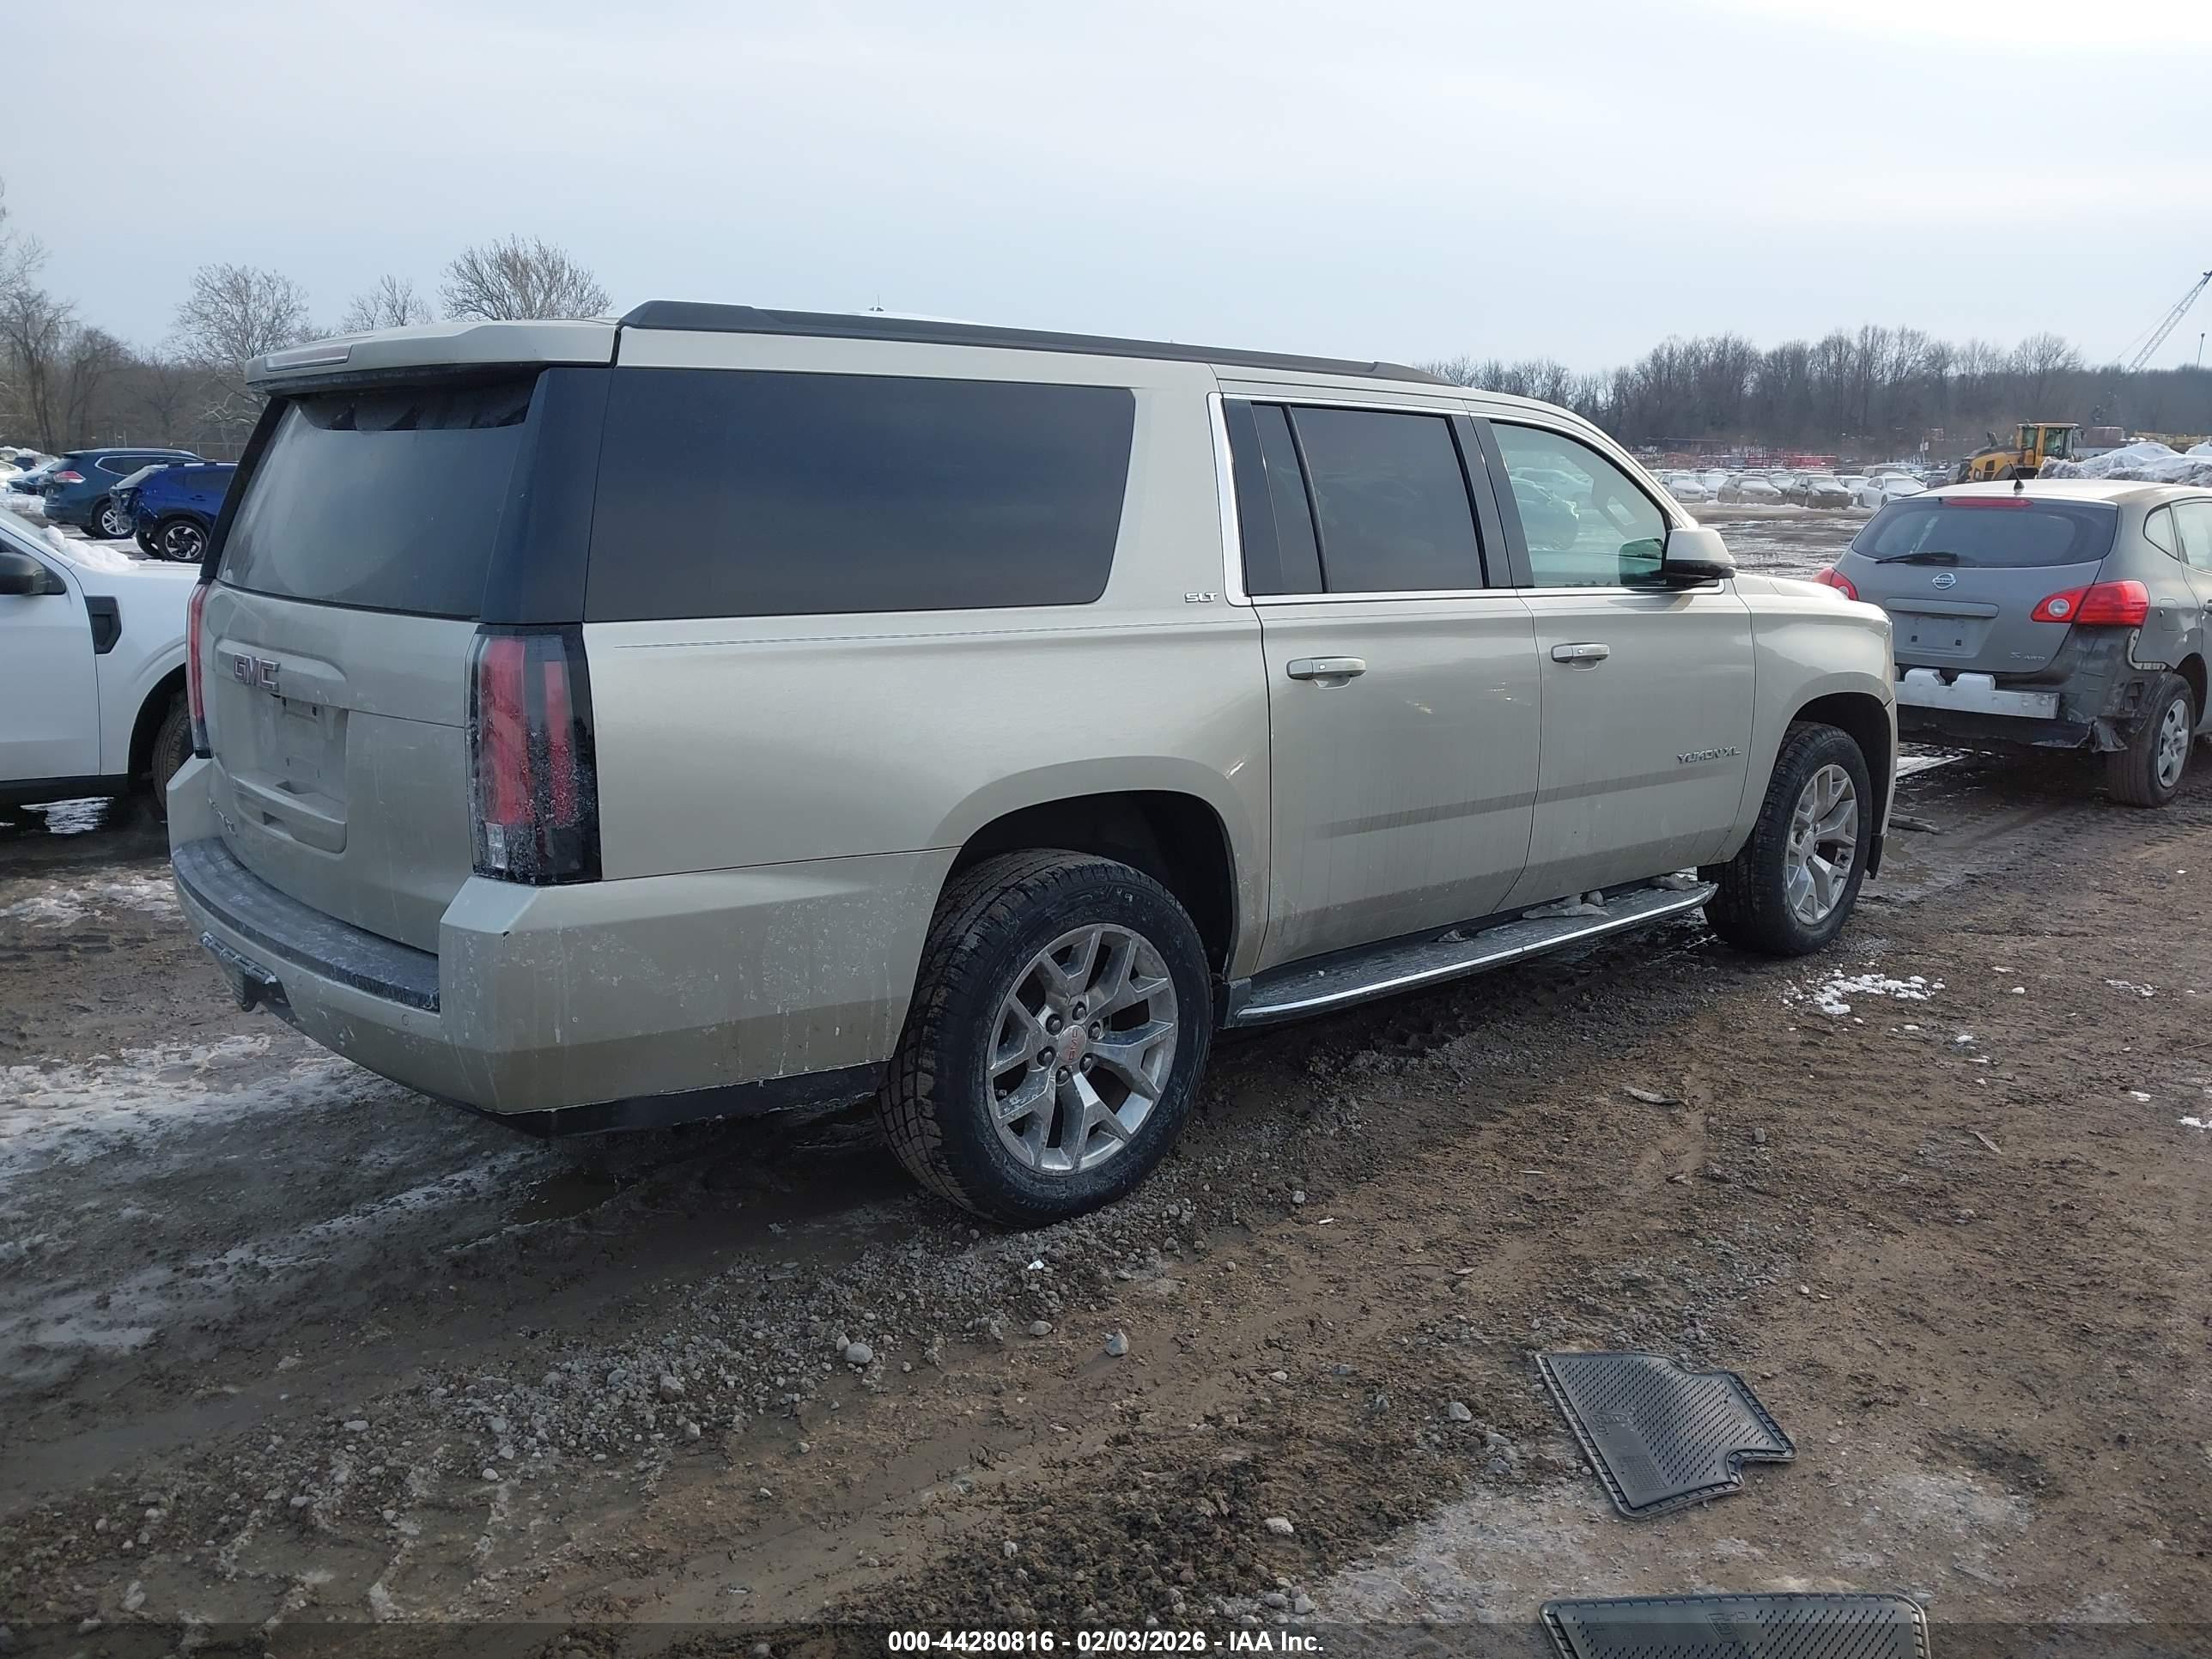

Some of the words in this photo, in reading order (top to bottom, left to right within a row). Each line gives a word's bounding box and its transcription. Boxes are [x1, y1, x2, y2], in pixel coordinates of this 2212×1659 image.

[1185, 592, 1218, 603] SLT
[233, 652, 281, 691] GMC
[1677, 748, 1723, 764] YUKON
[1068, 1029, 1079, 1060] GMC
